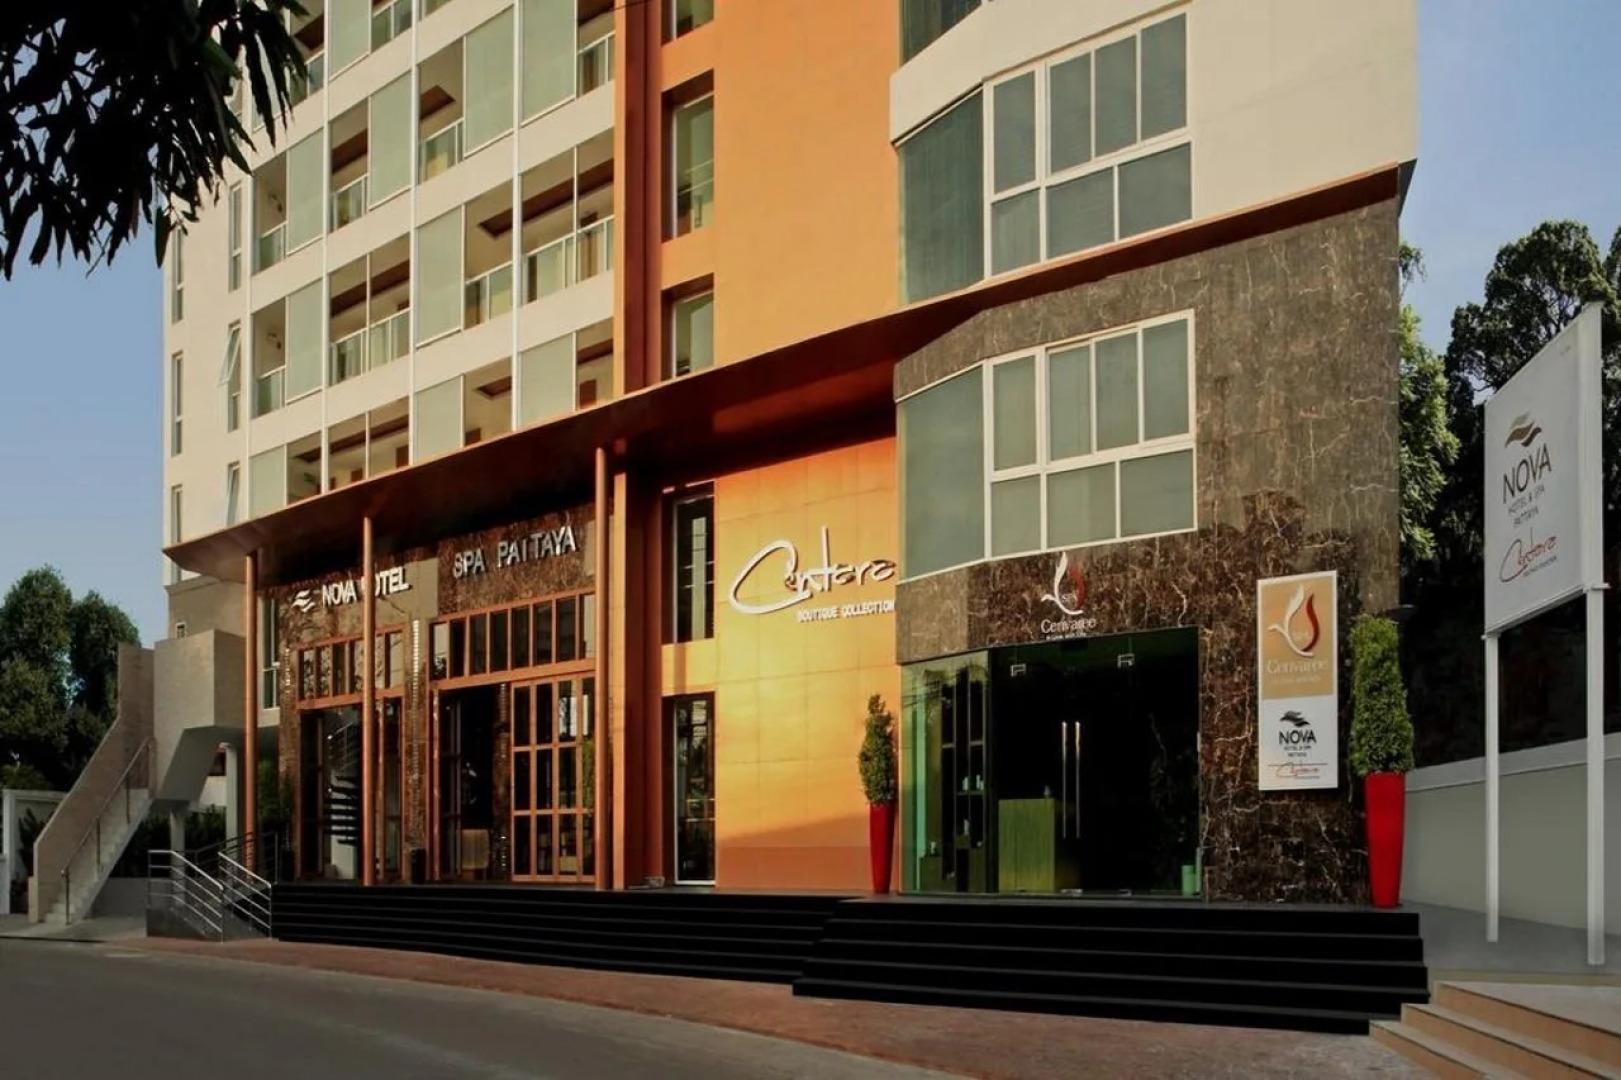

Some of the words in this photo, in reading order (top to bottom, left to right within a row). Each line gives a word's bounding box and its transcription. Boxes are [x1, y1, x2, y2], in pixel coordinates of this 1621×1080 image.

[1503, 442, 1552, 504] NOVA
[452, 547, 486, 579] SPA
[497, 525, 576, 568] PATTAYA
[729, 525, 896, 614] Centara
[322, 578, 357, 607] NOVA
[361, 566, 409, 597] TEL
[1279, 729, 1317, 745] NOVA
